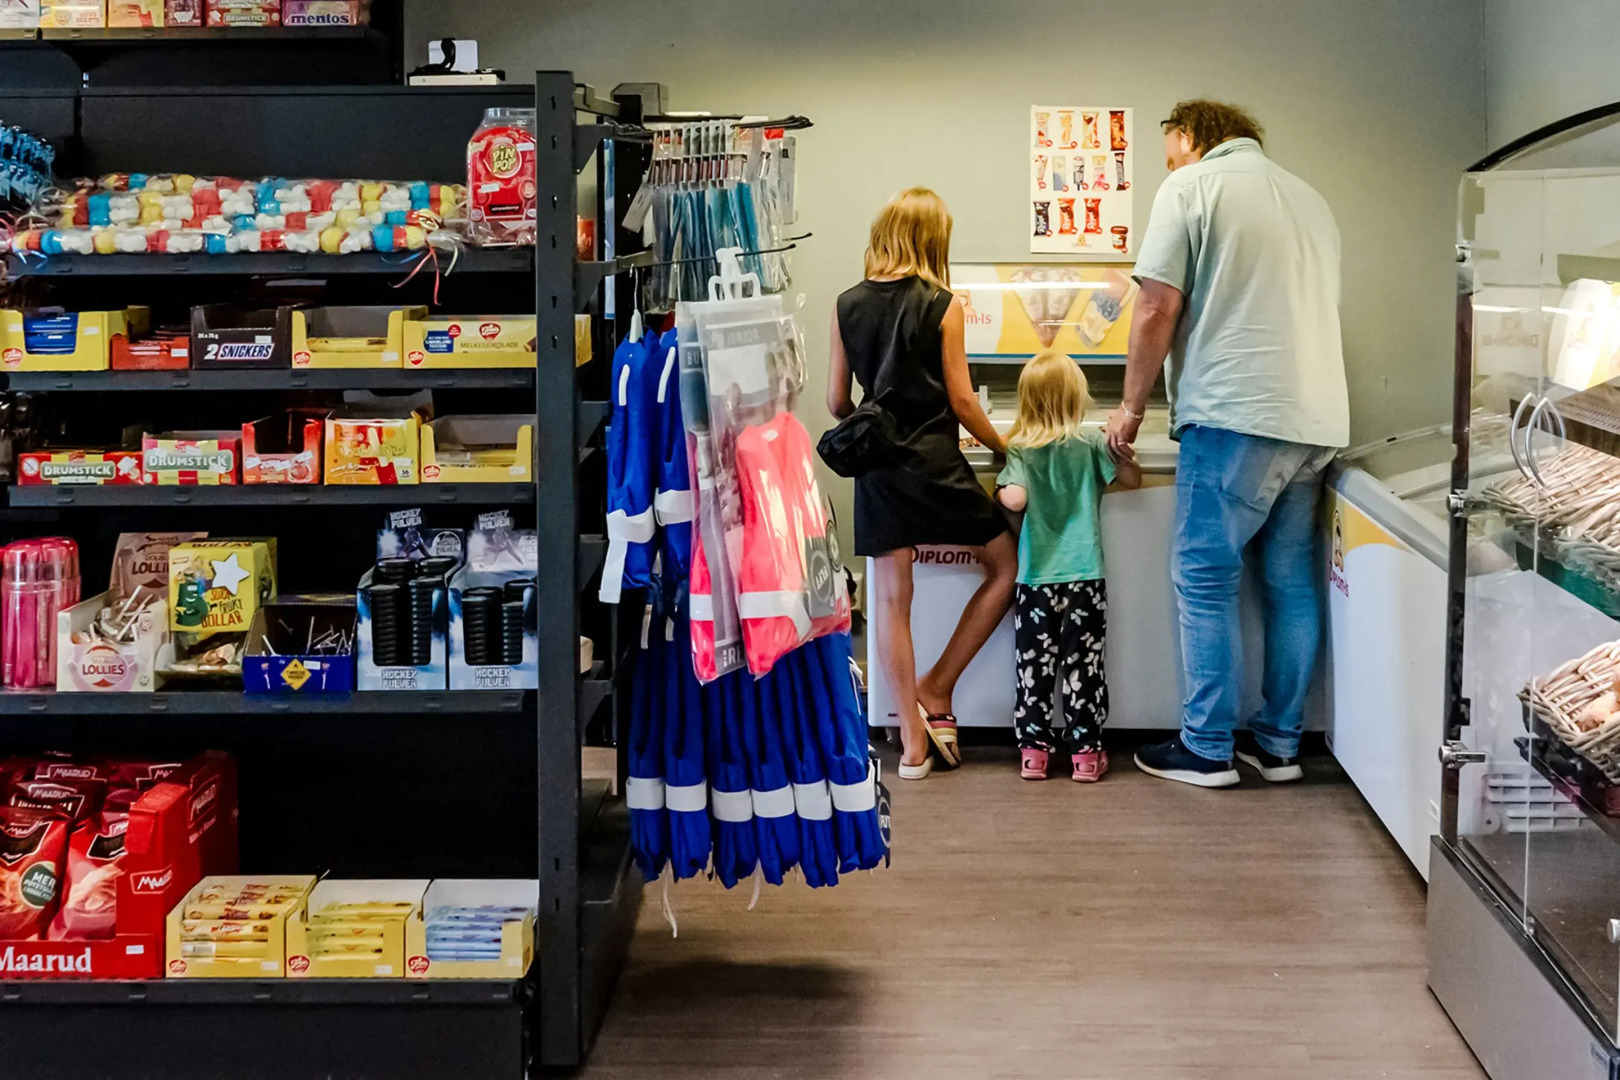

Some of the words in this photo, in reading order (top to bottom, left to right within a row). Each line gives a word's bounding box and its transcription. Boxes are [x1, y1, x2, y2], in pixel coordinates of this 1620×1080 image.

[290, 13, 349, 24] mentos
[492, 158, 516, 174] POP
[204, 344, 219, 360] 2
[220, 345, 272, 358] SNICKERS
[149, 455, 228, 468] DRUMSTICK
[44, 466, 111, 475] DRUMSTICK
[389, 508, 421, 520] HOCKEY
[478, 510, 509, 522] HOCKEY
[391, 516, 422, 529] PULVER
[479, 517, 510, 531] PULVER
[219, 598, 243, 614] FRUKT
[82, 664, 124, 676] LOLLIES
[382, 669, 417, 680] HOCKEY
[475, 667, 510, 678] HOCKEY
[382, 679, 417, 689] PULVER
[475, 677, 510, 688] PULVER
[32, 871, 57, 888] MER
[0, 946, 93, 973] Maarud
